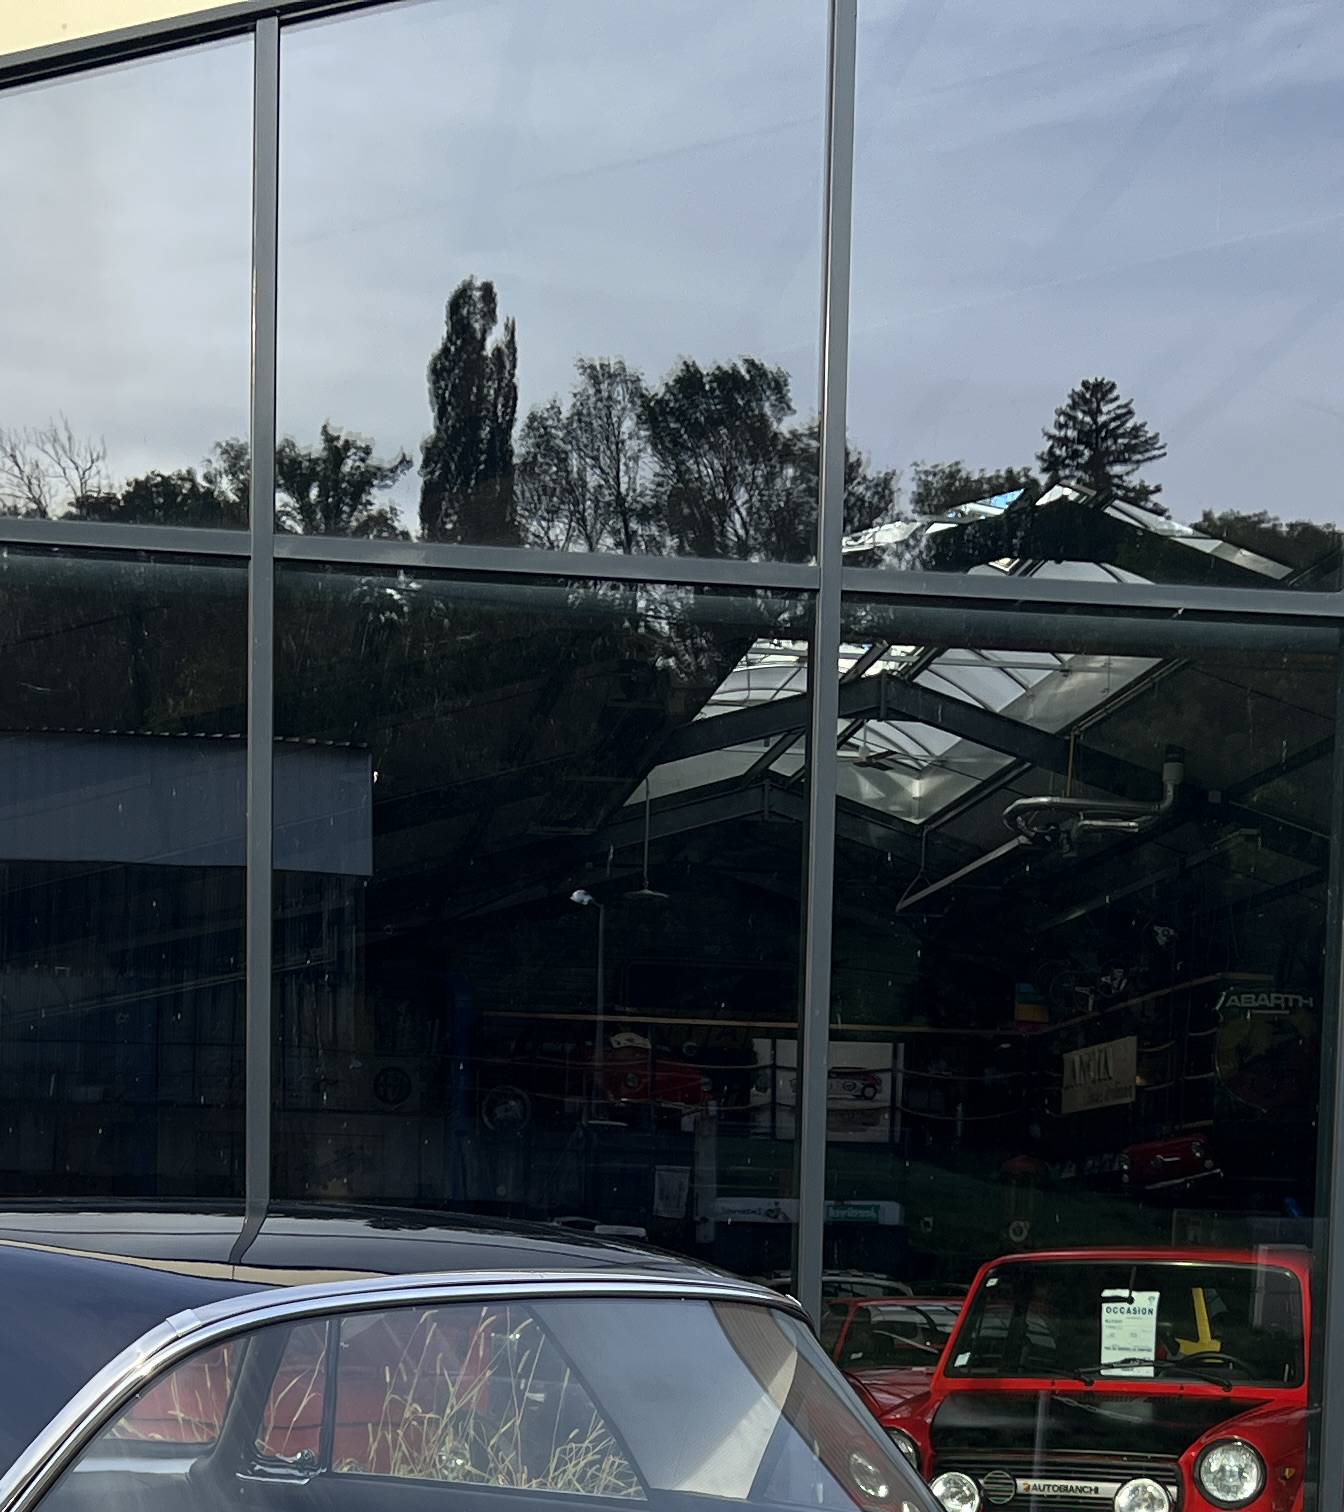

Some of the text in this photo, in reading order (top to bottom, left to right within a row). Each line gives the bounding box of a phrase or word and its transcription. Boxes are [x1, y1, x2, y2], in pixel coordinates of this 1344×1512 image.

[1225, 993, 1315, 1010] ABARTH
[1105, 1306, 1154, 1316] OCCASION
[1031, 1484, 1100, 1495] AUTOBIANCHI
